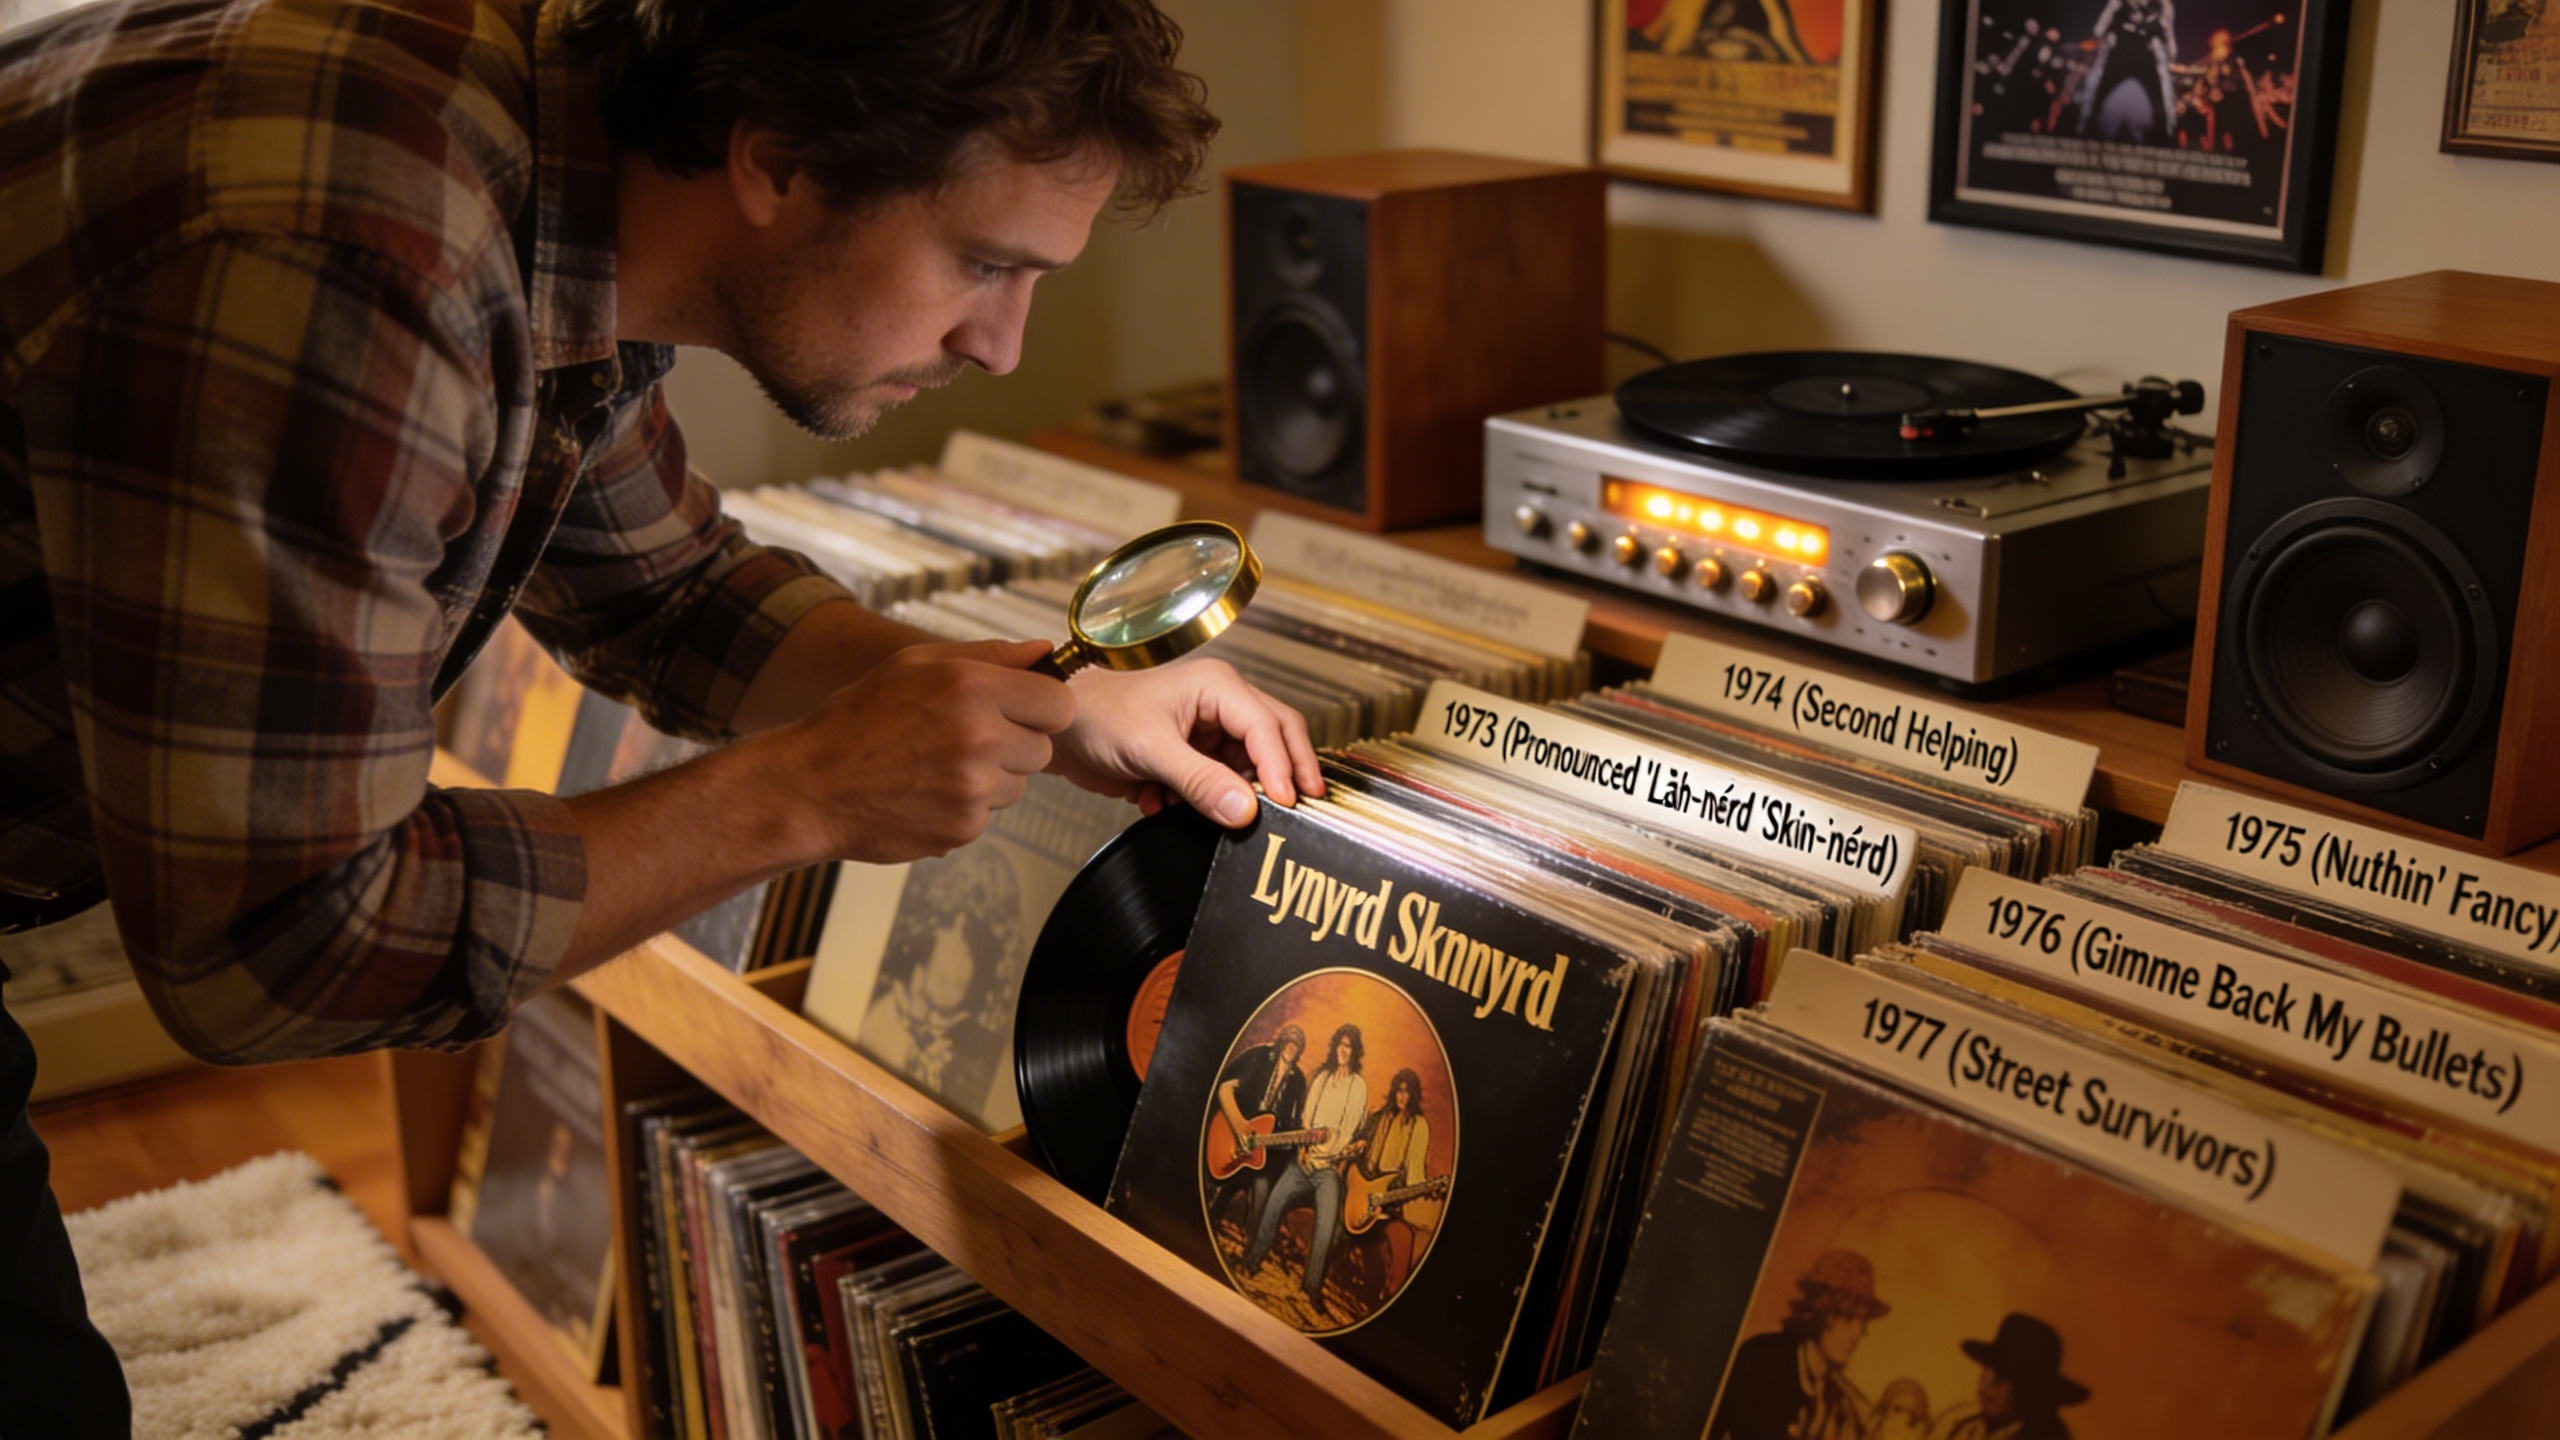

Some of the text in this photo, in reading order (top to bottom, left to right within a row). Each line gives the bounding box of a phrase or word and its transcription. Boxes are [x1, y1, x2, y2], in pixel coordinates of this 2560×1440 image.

[1444, 700, 1499, 748] 1973
[1502, 716, 1642, 796] (Pronounced
[1723, 663, 2018, 787] 1974 (Second Helping)
[1250, 832, 1394, 950] Lynyrd
[2226, 812, 2307, 867] 1975
[2311, 832, 2447, 906] (Nuthin'
[1987, 896, 2524, 1115] 1976 (Gimme Back My Bullets)
[1862, 998, 1947, 1061] 1977
[1948, 1028, 2073, 1116] (Street
[2077, 1077, 2276, 1202] Survivors)
